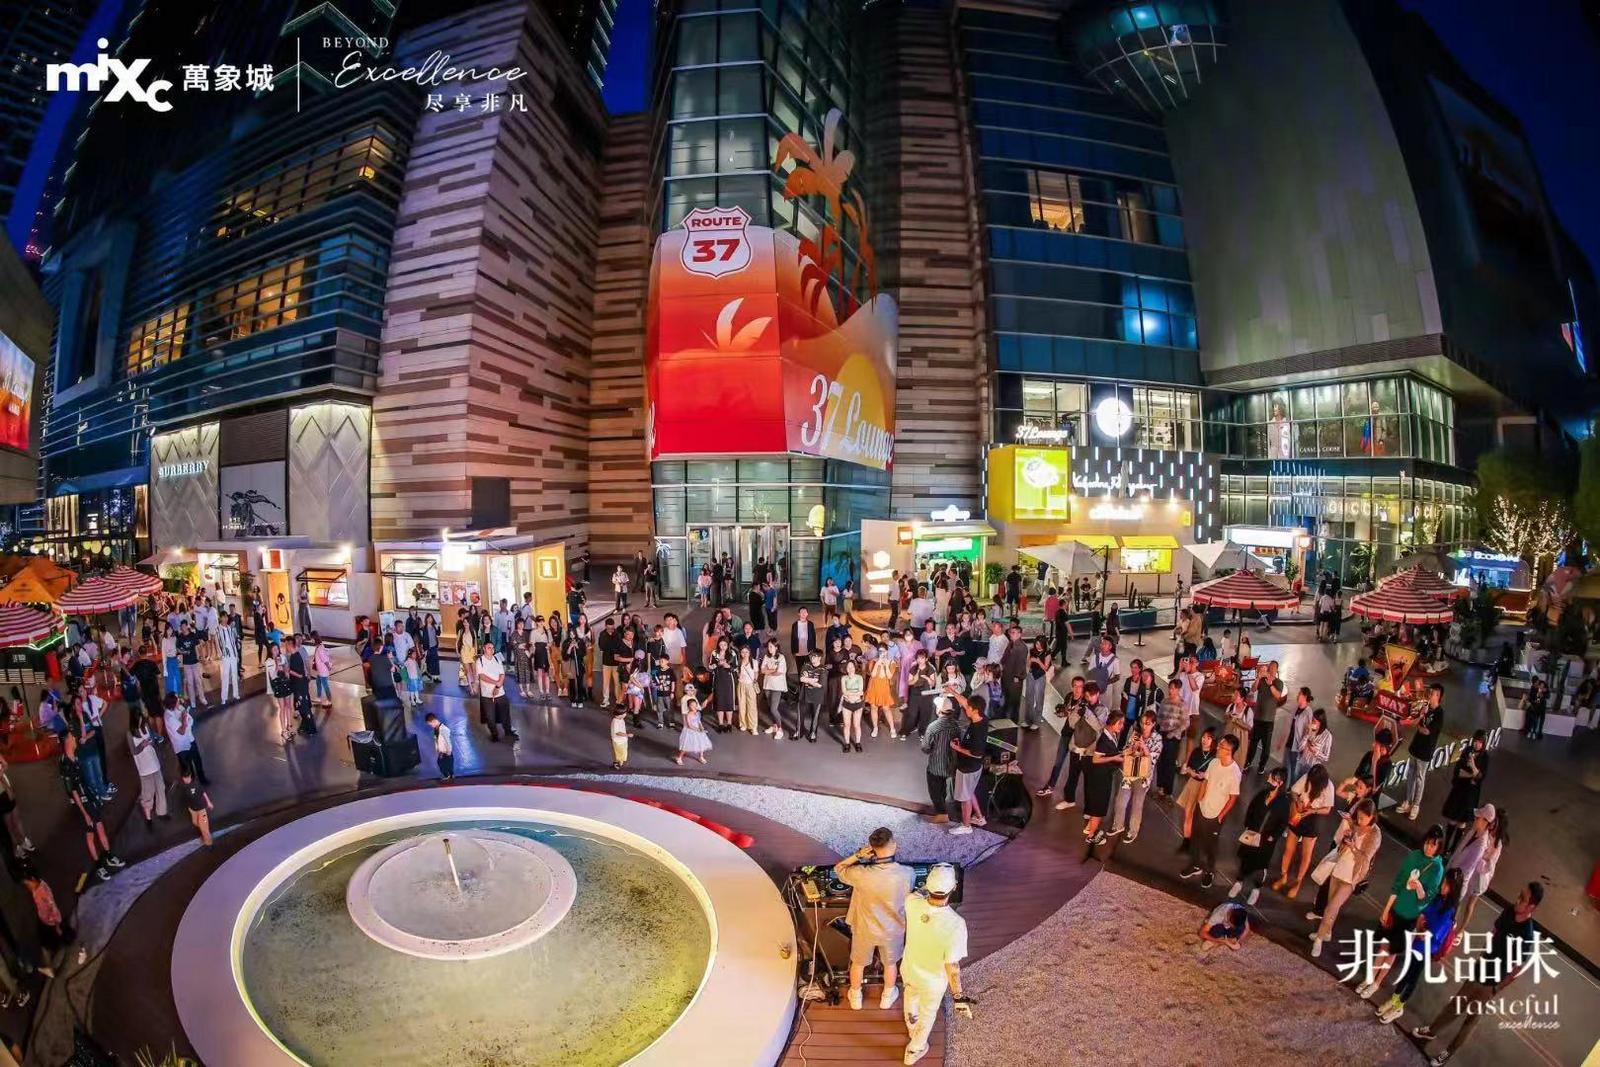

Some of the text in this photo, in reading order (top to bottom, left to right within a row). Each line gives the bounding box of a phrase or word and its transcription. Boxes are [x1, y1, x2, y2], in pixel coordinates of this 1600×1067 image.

[691, 215, 743, 228] ROUTE
[692, 238, 741, 263] 37
[801, 373, 843, 451] 37
[157, 459, 209, 479] BURBERRY
[1378, 694, 1406, 714] WAY
